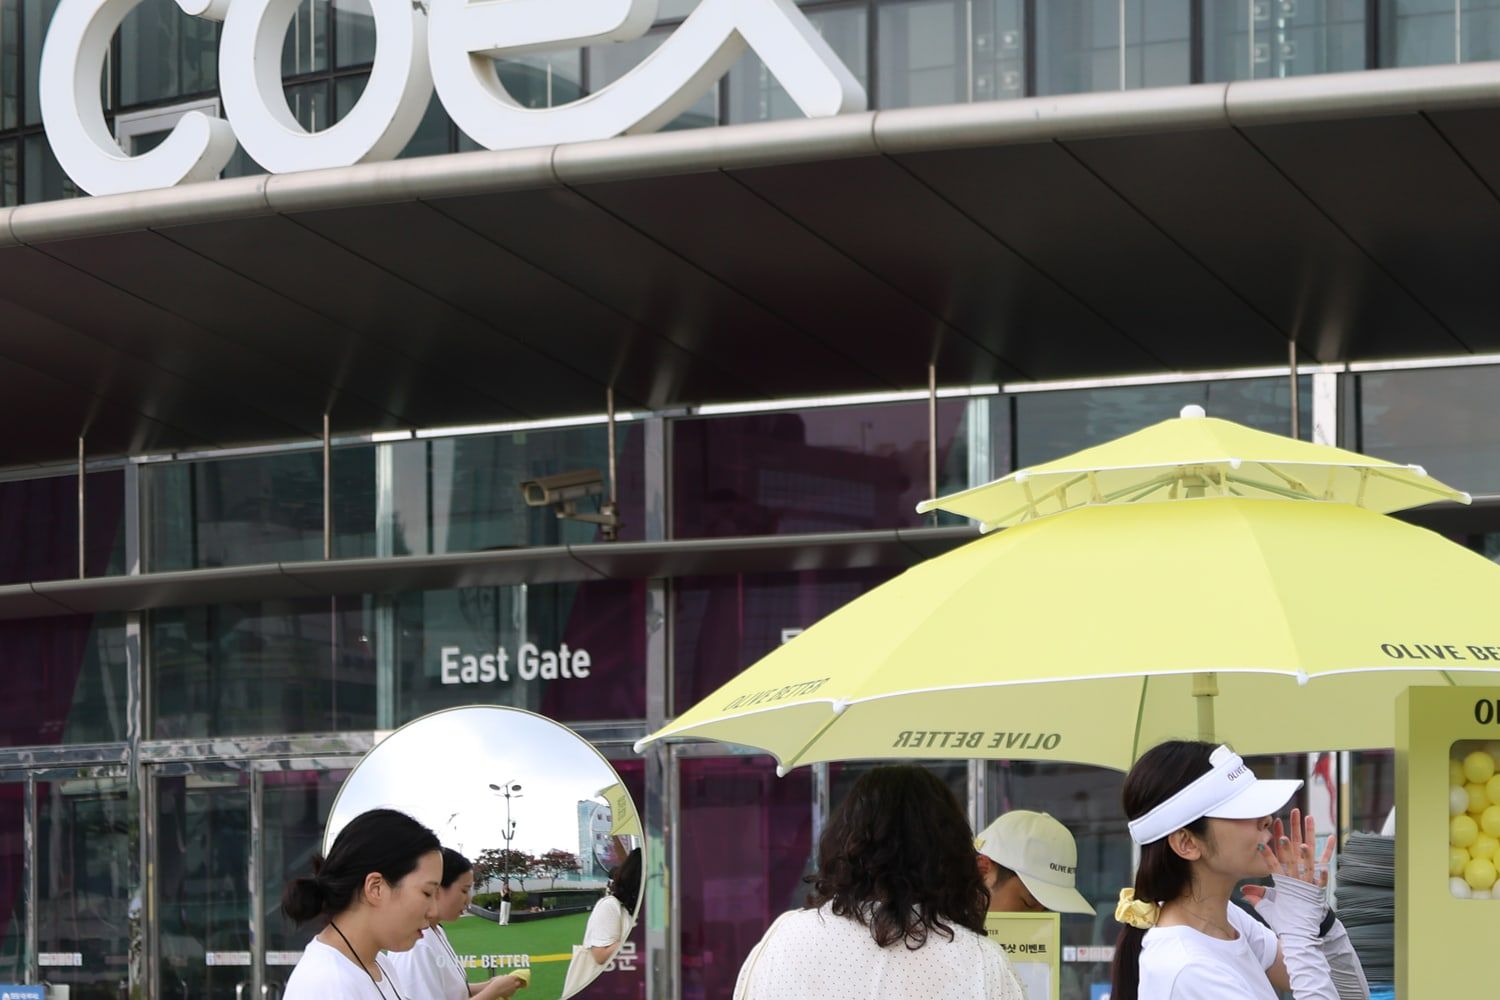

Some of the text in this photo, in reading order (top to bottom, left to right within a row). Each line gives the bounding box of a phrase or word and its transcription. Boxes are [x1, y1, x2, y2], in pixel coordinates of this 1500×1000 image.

[1381, 643, 1466, 660] OLIVE
[440, 642, 591, 684] East Gate
[604, 941, 638, 971] 문
[1019, 944, 1047, 953] 이벤트
[482, 954, 531, 968] BETTER
